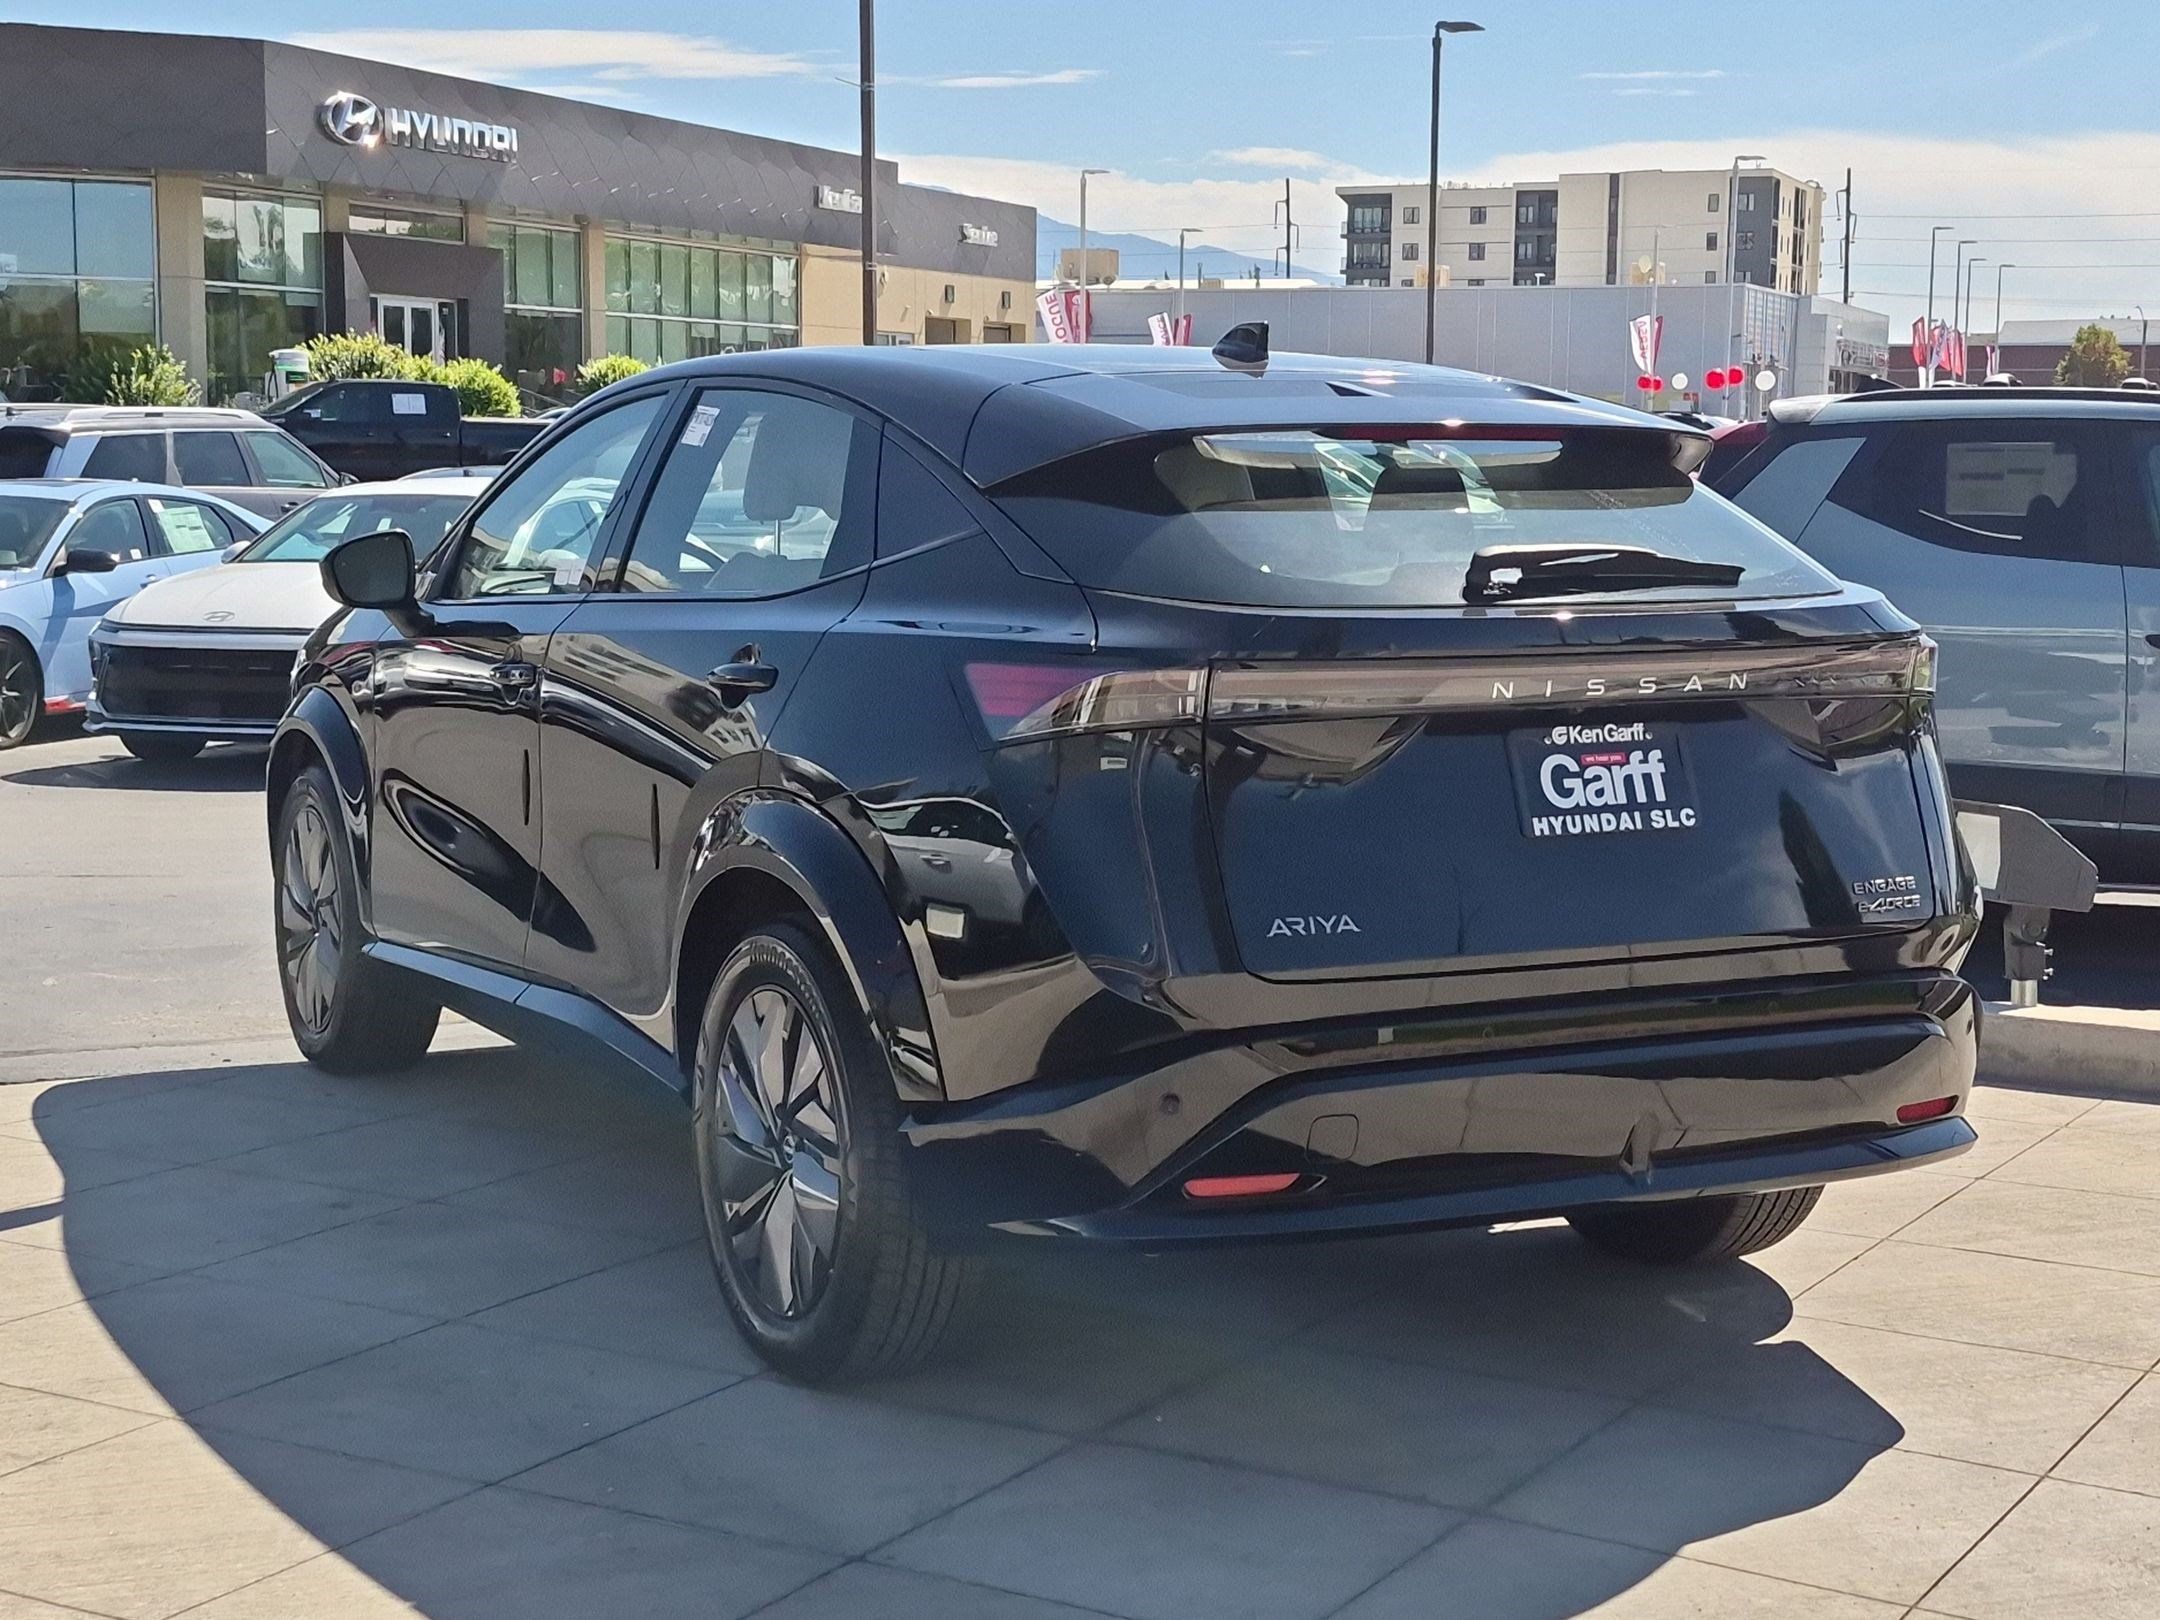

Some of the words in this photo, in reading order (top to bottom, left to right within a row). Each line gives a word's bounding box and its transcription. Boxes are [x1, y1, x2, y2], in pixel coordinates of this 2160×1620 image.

[388, 107, 518, 157] HYUNDAI
[1492, 673, 1748, 699] NISSAN
[1540, 749, 1666, 808] Garff
[1532, 811, 1642, 836] HYUNDAI
[1651, 808, 1696, 829] SLC
[1853, 876, 1916, 894] ENGAGE
[1266, 914, 1362, 938] ARIYA
